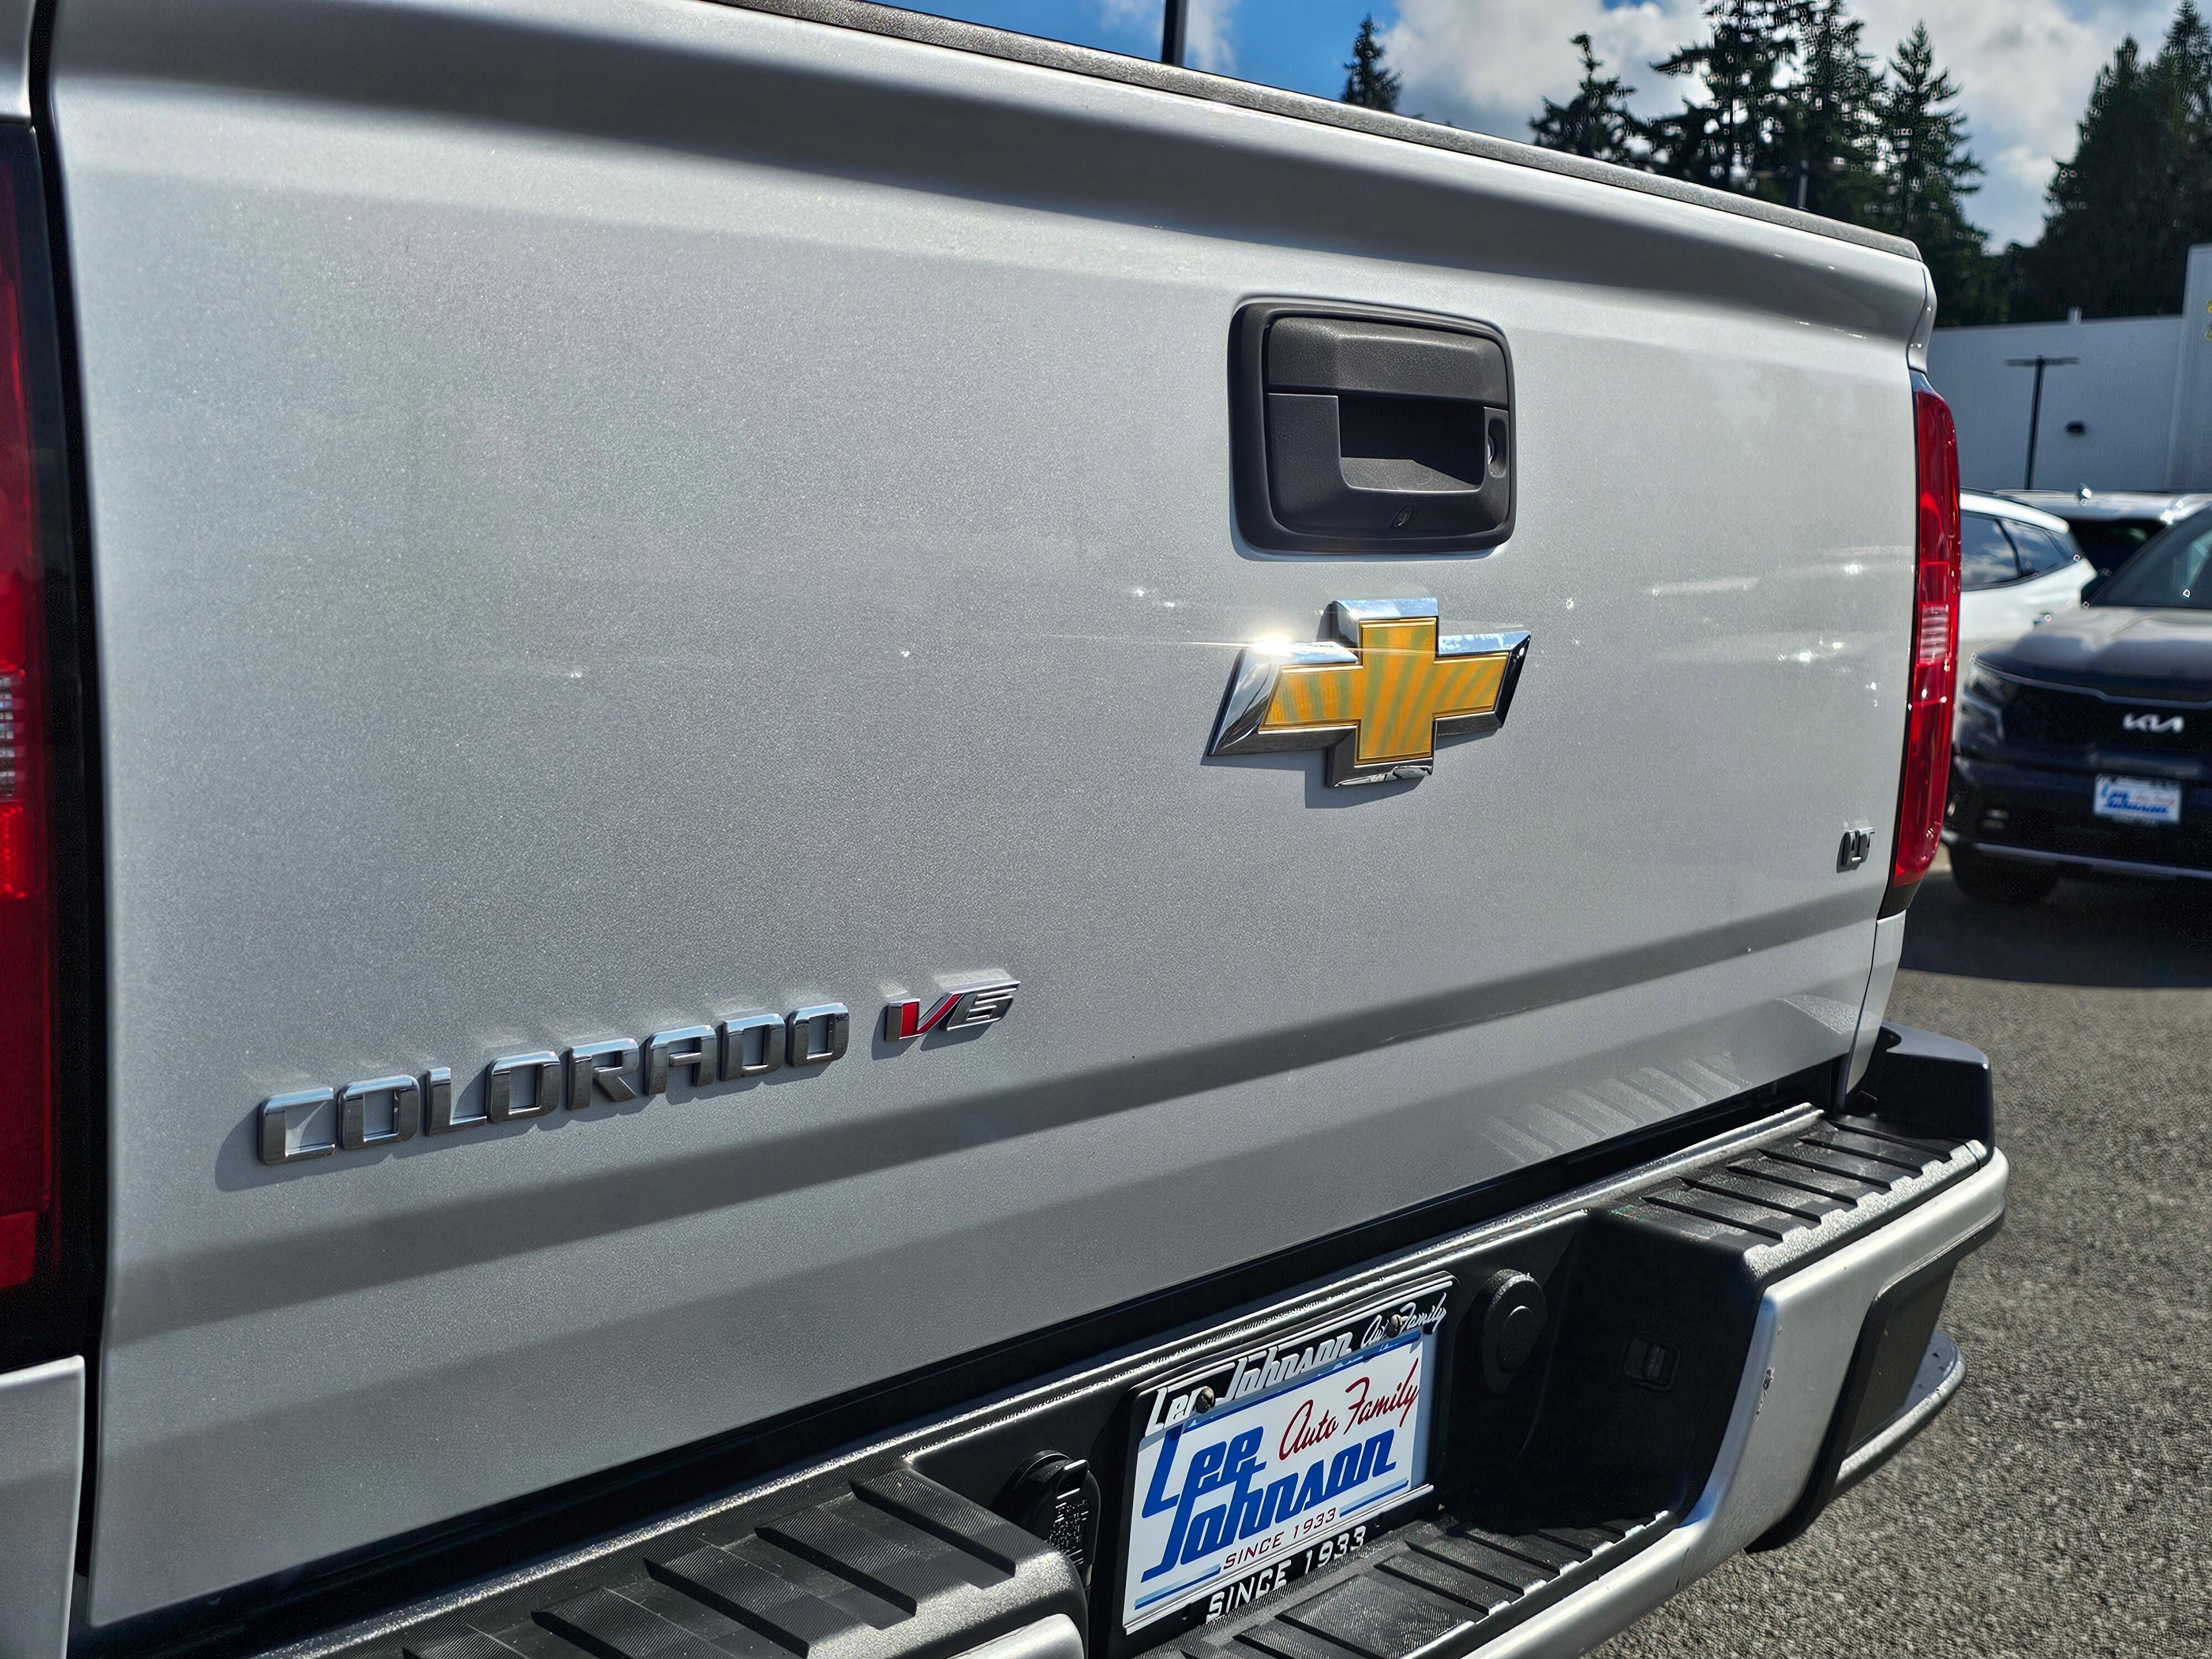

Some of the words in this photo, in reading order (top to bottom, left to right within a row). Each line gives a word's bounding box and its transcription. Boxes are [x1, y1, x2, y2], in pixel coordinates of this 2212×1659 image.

[258, 1003, 849, 1165] COLORADO
[885, 979, 1021, 1041] V6
[1215, 1332, 1353, 1405] Johnson
[1399, 1292, 1447, 1335] Family
[1279, 1399, 1339, 1460] Auto
[1343, 1357, 1420, 1435] Family
[1140, 1428, 1397, 1583] Johnson
[1142, 1425, 1264, 1519] Lee
[1206, 1559, 1292, 1623] SINCE
[1305, 1525, 1366, 1574] 1933
[1223, 1531, 1285, 1569] SINCE
[1293, 1507, 1336, 1539] 1933
